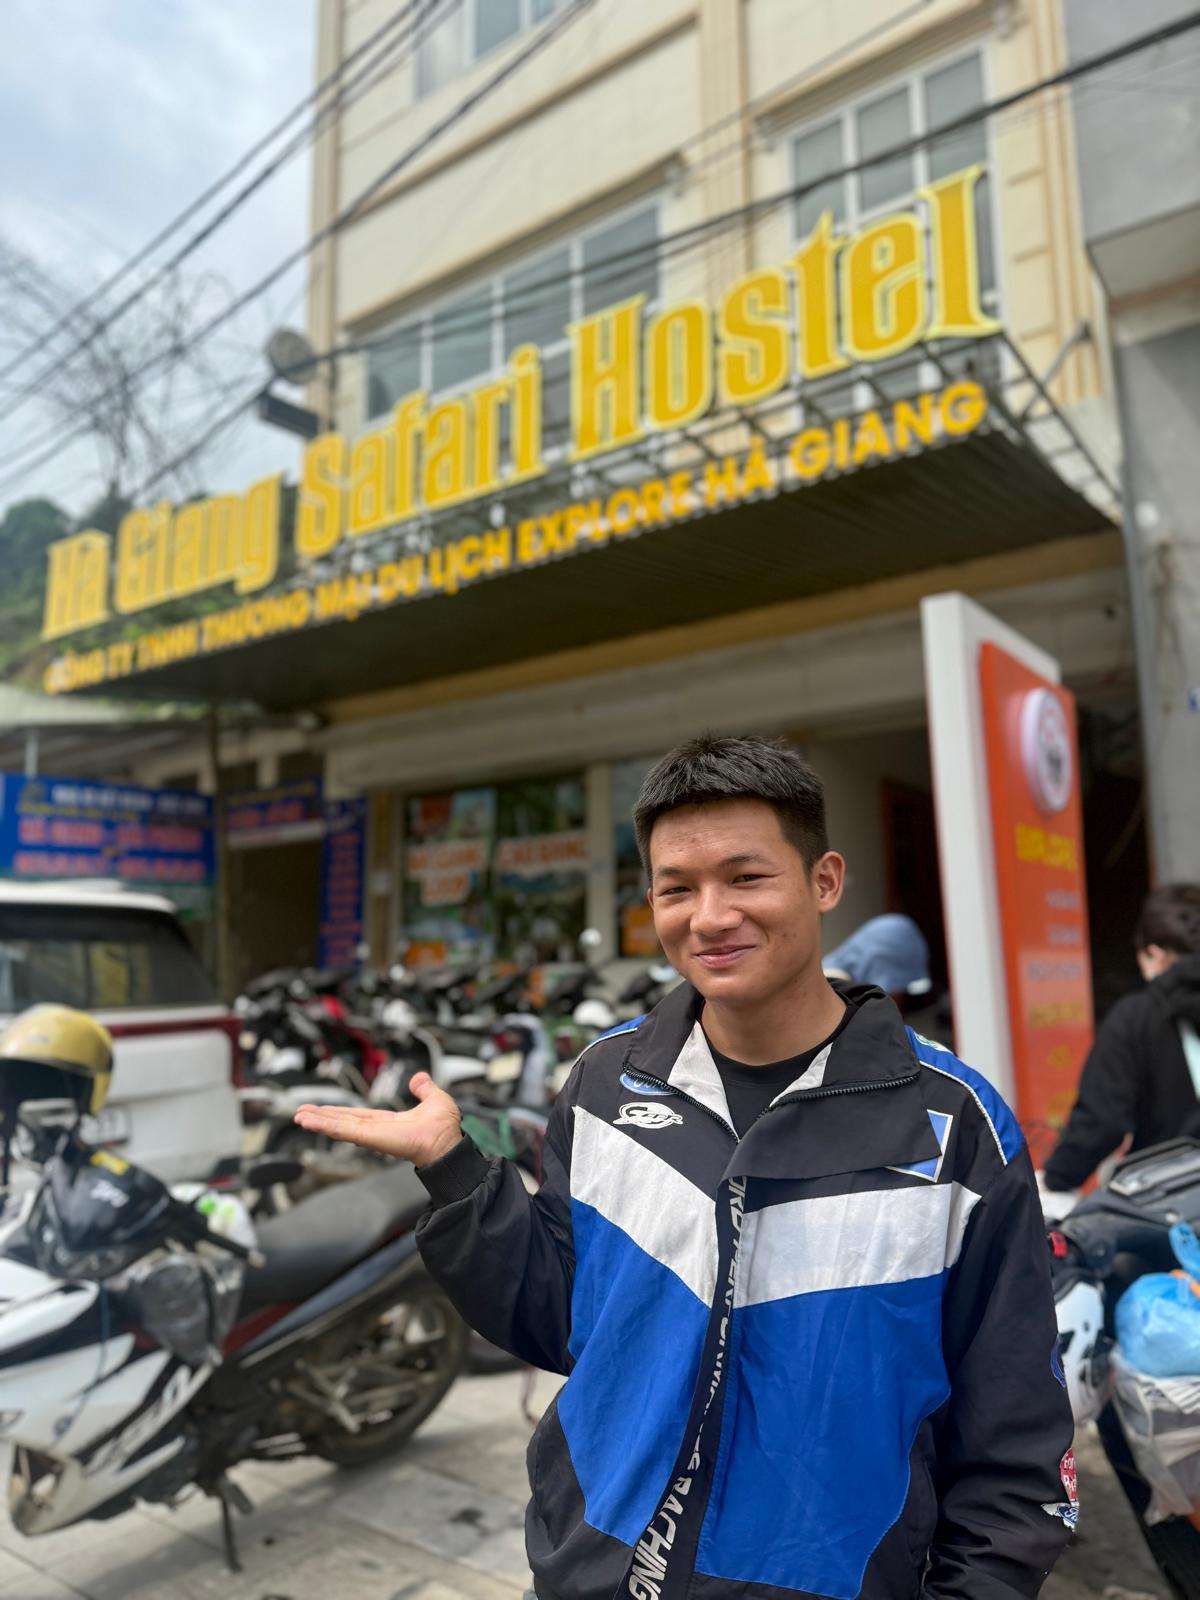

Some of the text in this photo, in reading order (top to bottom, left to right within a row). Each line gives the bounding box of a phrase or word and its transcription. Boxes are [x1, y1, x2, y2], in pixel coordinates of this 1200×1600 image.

[114, 470, 284, 614] Giang
[294, 343, 549, 558] Safari
[566, 164, 1001, 463] Hostel
[516, 471, 694, 564] EXPLORE
[789, 379, 988, 480] GIANG
